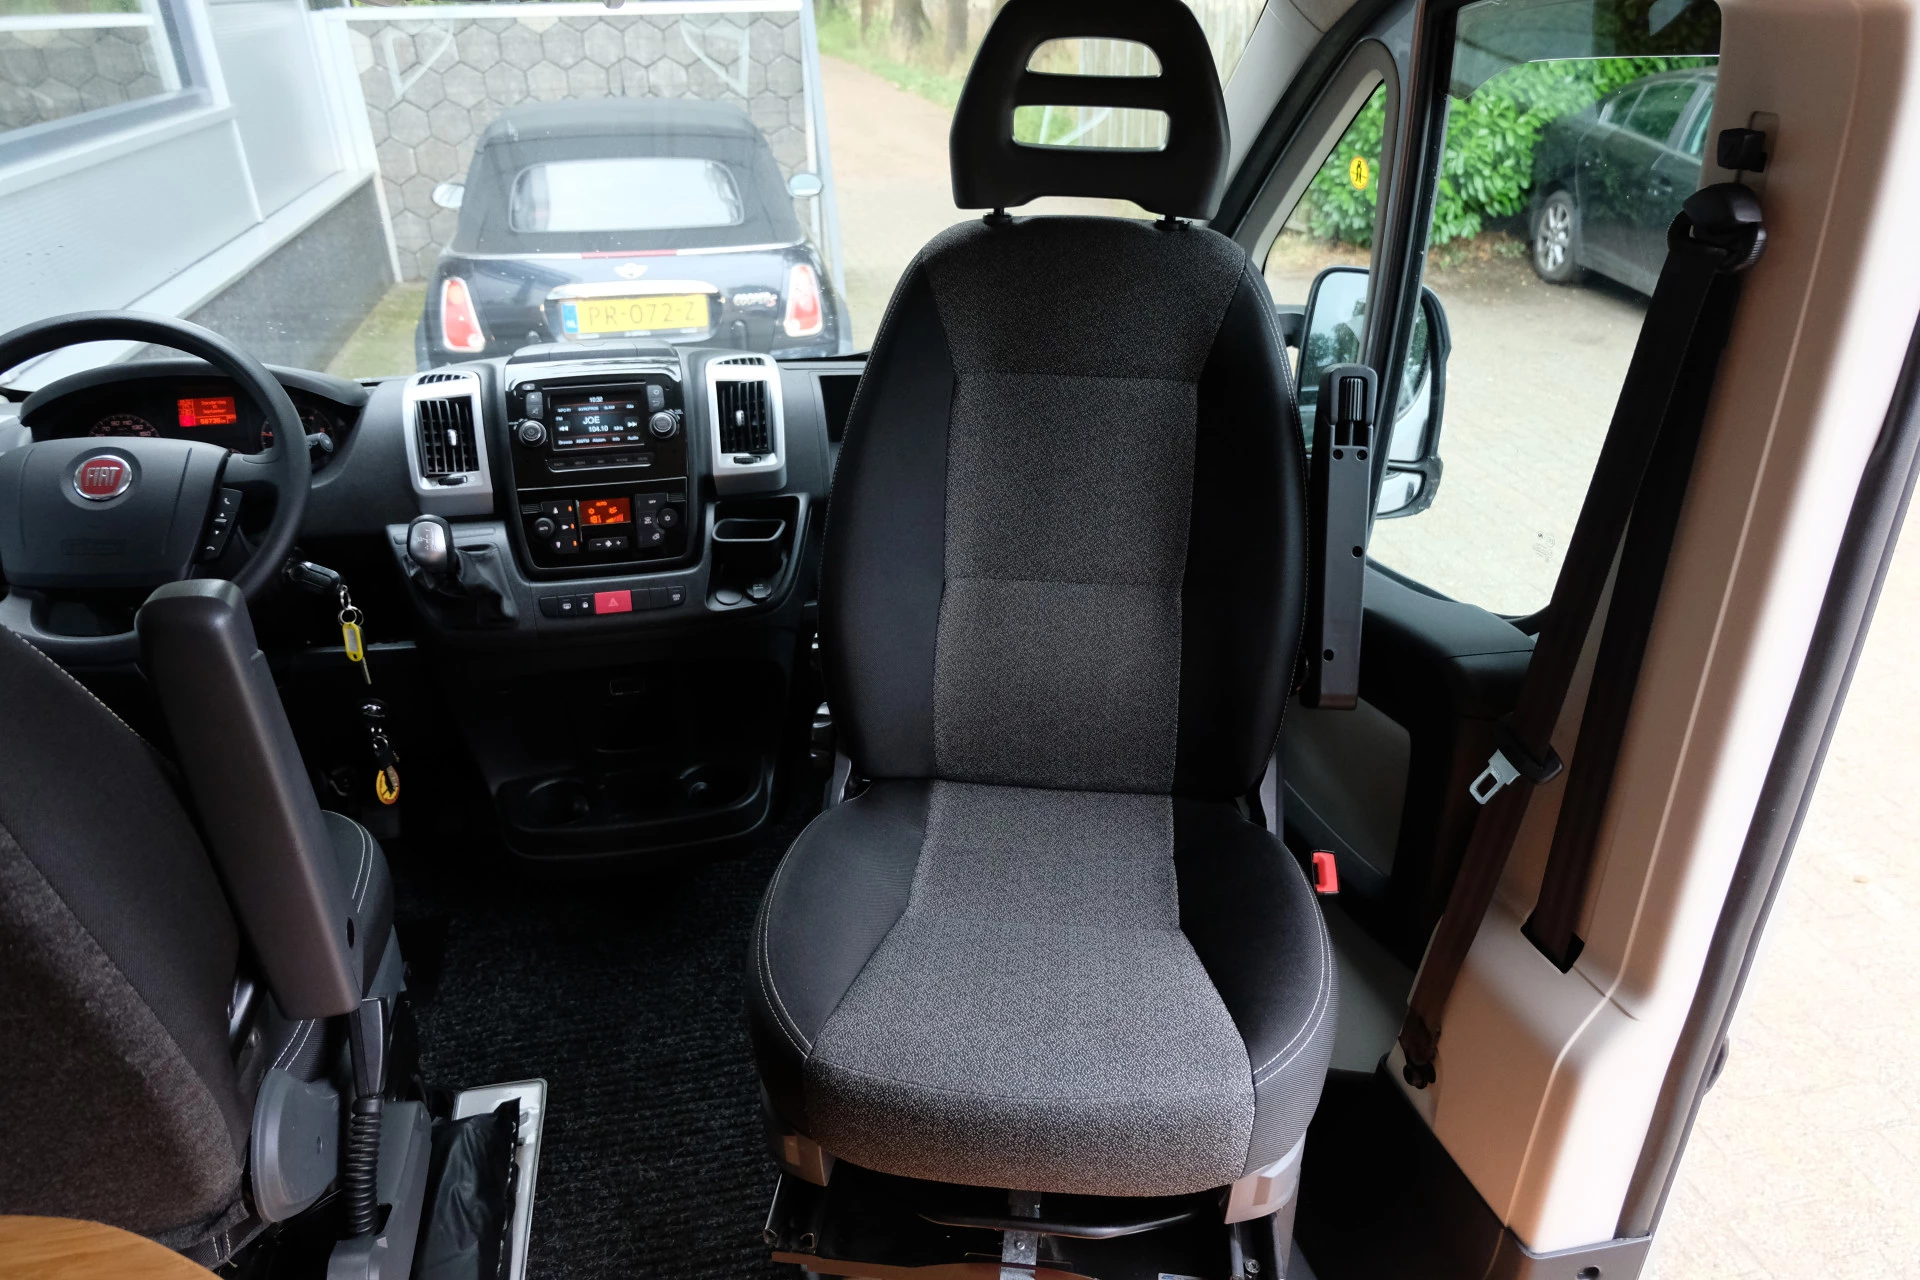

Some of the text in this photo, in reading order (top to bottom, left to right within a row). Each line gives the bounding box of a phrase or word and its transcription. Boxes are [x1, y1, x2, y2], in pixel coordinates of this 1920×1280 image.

[582, 415, 600, 425] JOE
[588, 425, 609, 433] 104.10
[85, 466, 121, 487] FIAT
